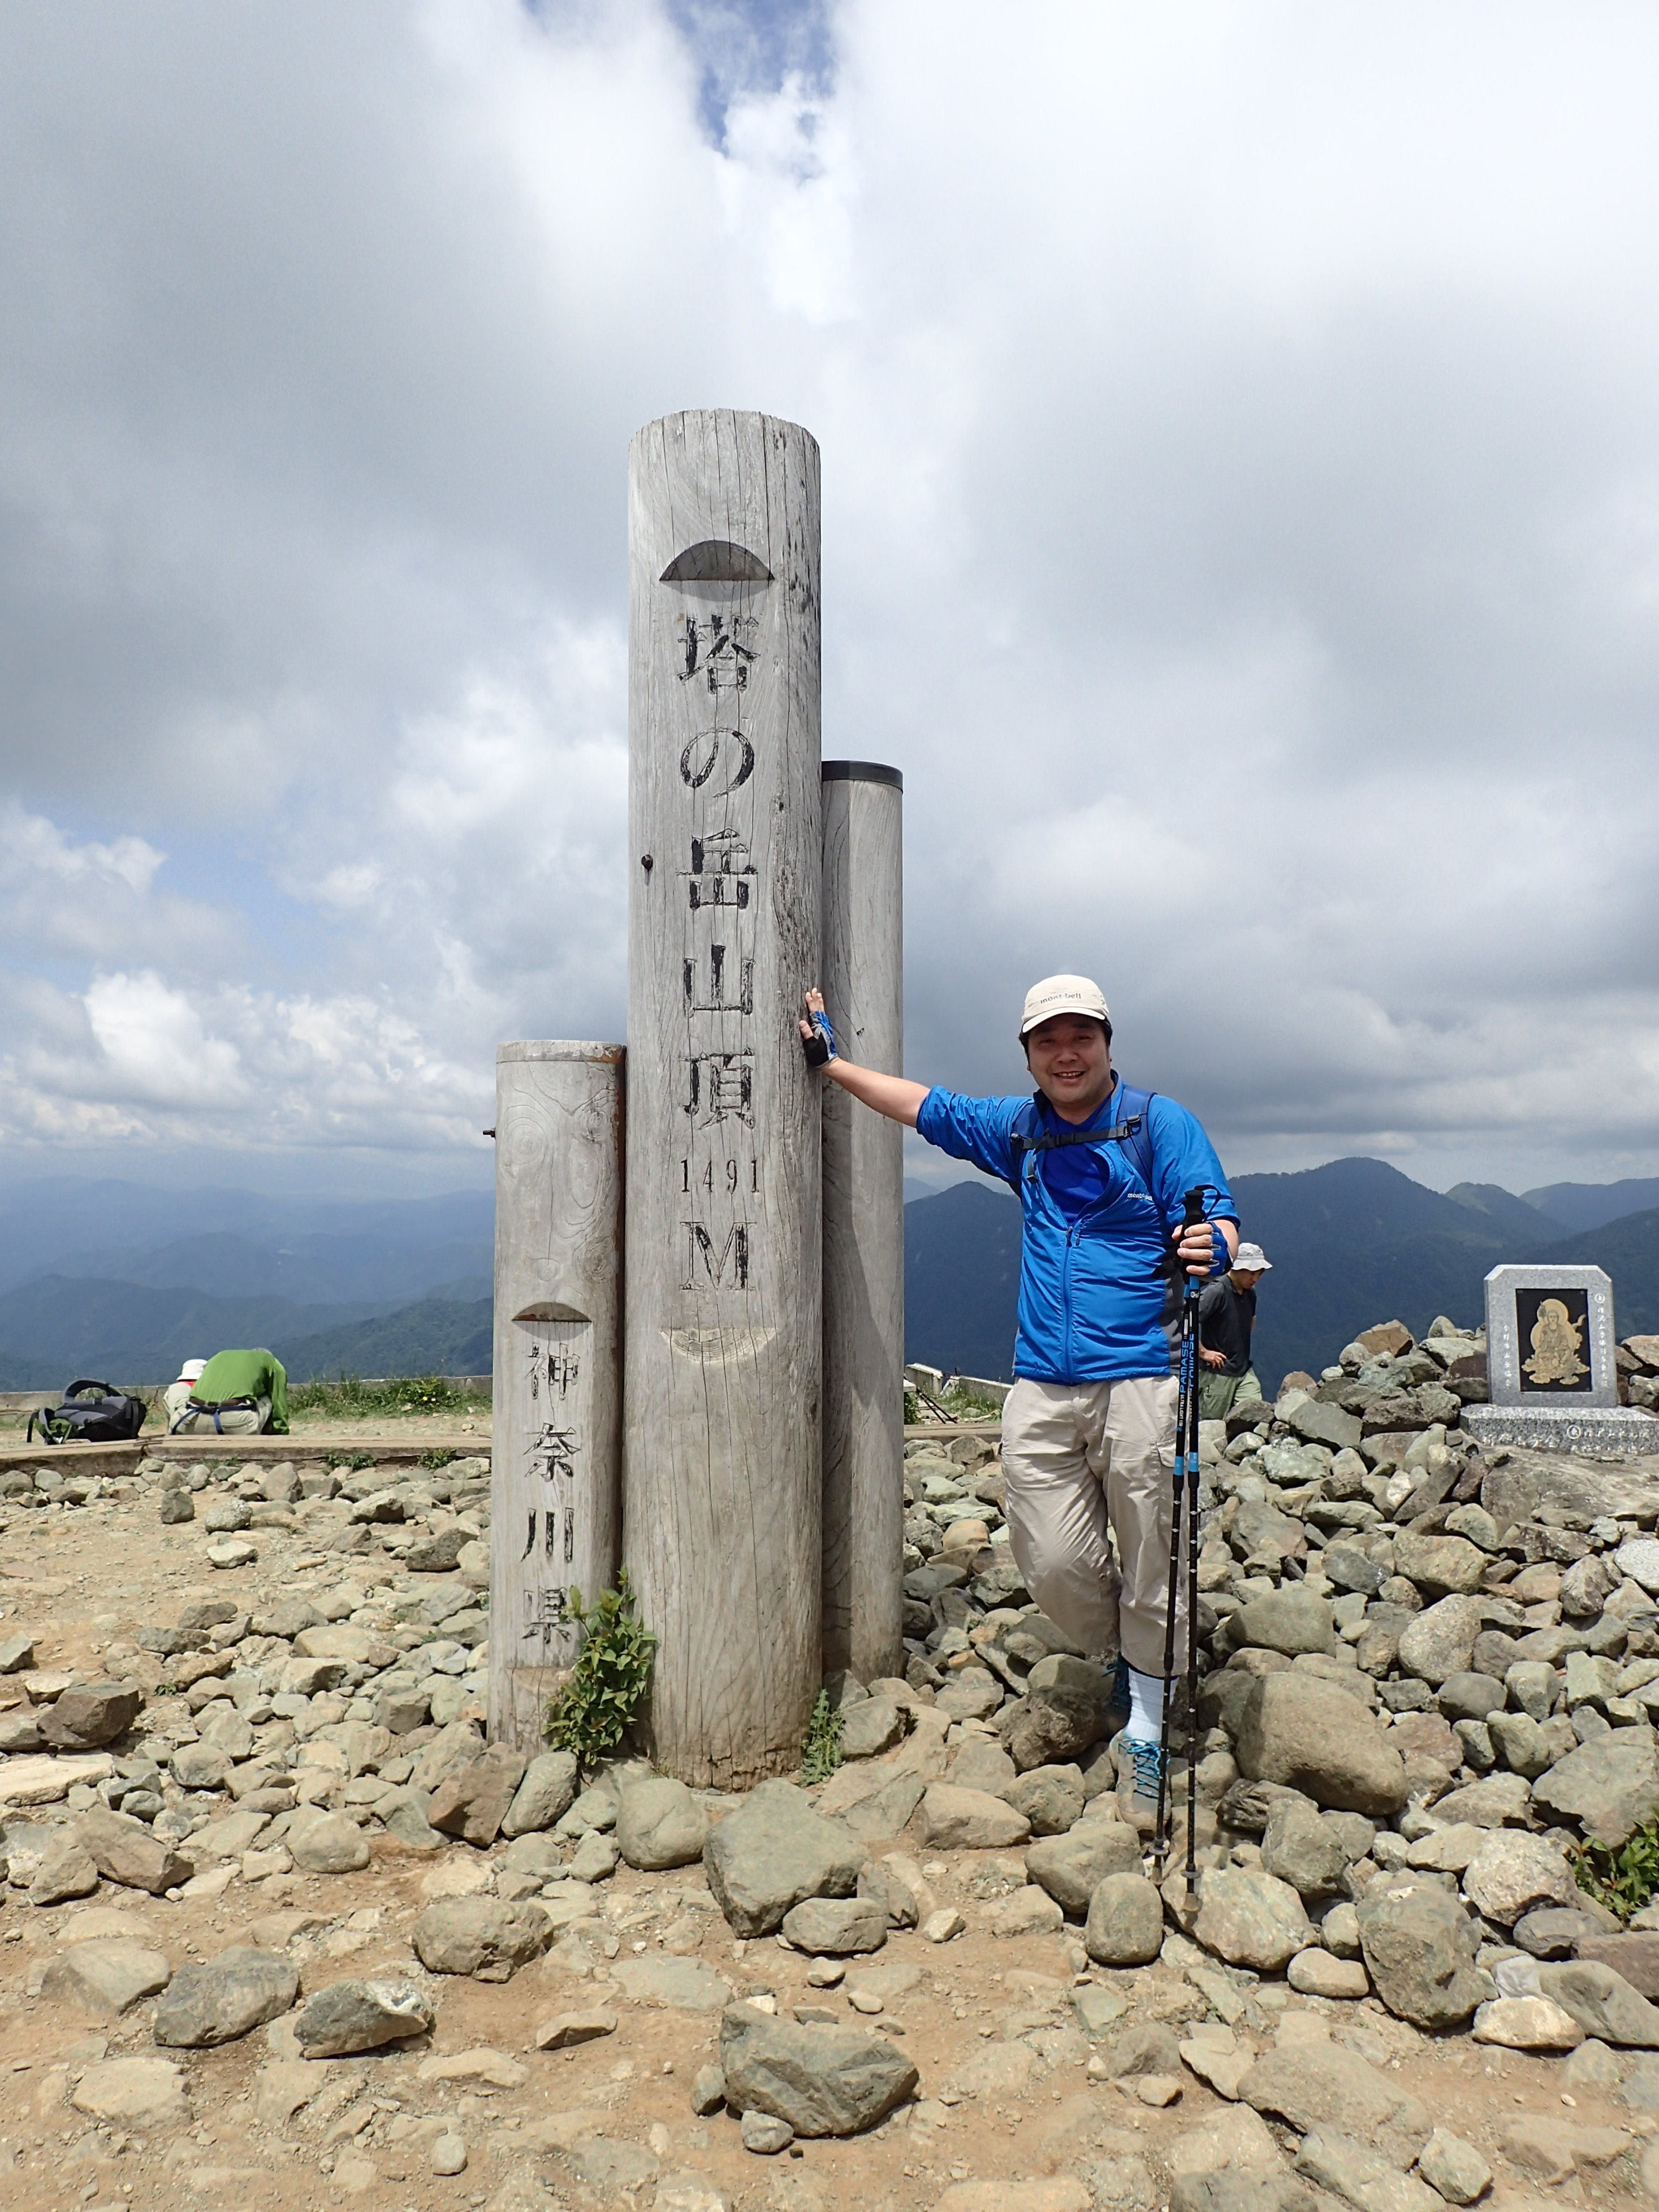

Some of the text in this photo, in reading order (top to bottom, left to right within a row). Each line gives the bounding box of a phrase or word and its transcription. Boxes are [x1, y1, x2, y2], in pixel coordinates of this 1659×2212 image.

[676, 614, 761, 1130] 塔の岳山頂
[680, 1159, 759, 1195] 1491
[679, 1222, 757, 1291] M
[1179, 1341, 1189, 1393] PAMASE
[520, 1342, 582, 1645] 神奈川県
